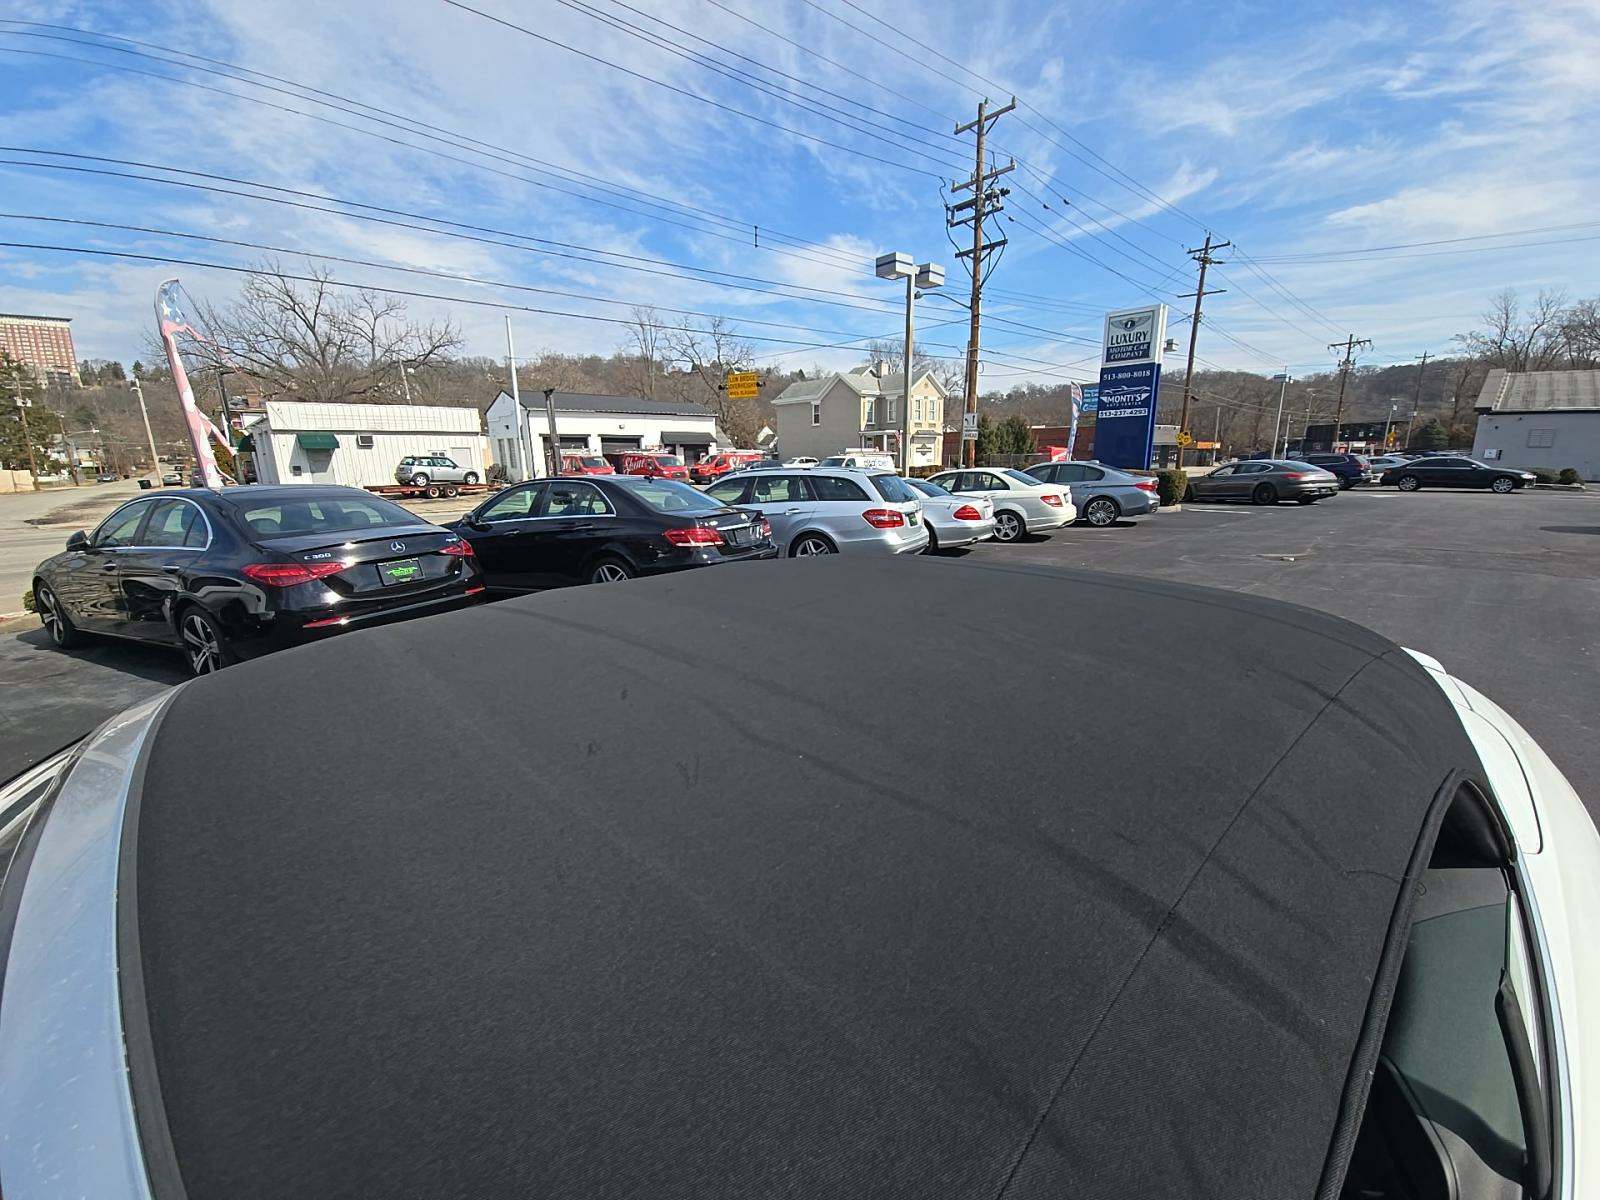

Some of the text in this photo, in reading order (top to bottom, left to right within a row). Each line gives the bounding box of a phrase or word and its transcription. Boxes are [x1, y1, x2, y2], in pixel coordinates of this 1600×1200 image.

[1110, 331, 1148, 345] LUXURY
[1109, 343, 1148, 354] MOTOR CAR
[1111, 351, 1143, 359] COMPANY
[1103, 370, 1150, 380] 513-800-8018
[1107, 394, 1141, 403] MONTI'S
